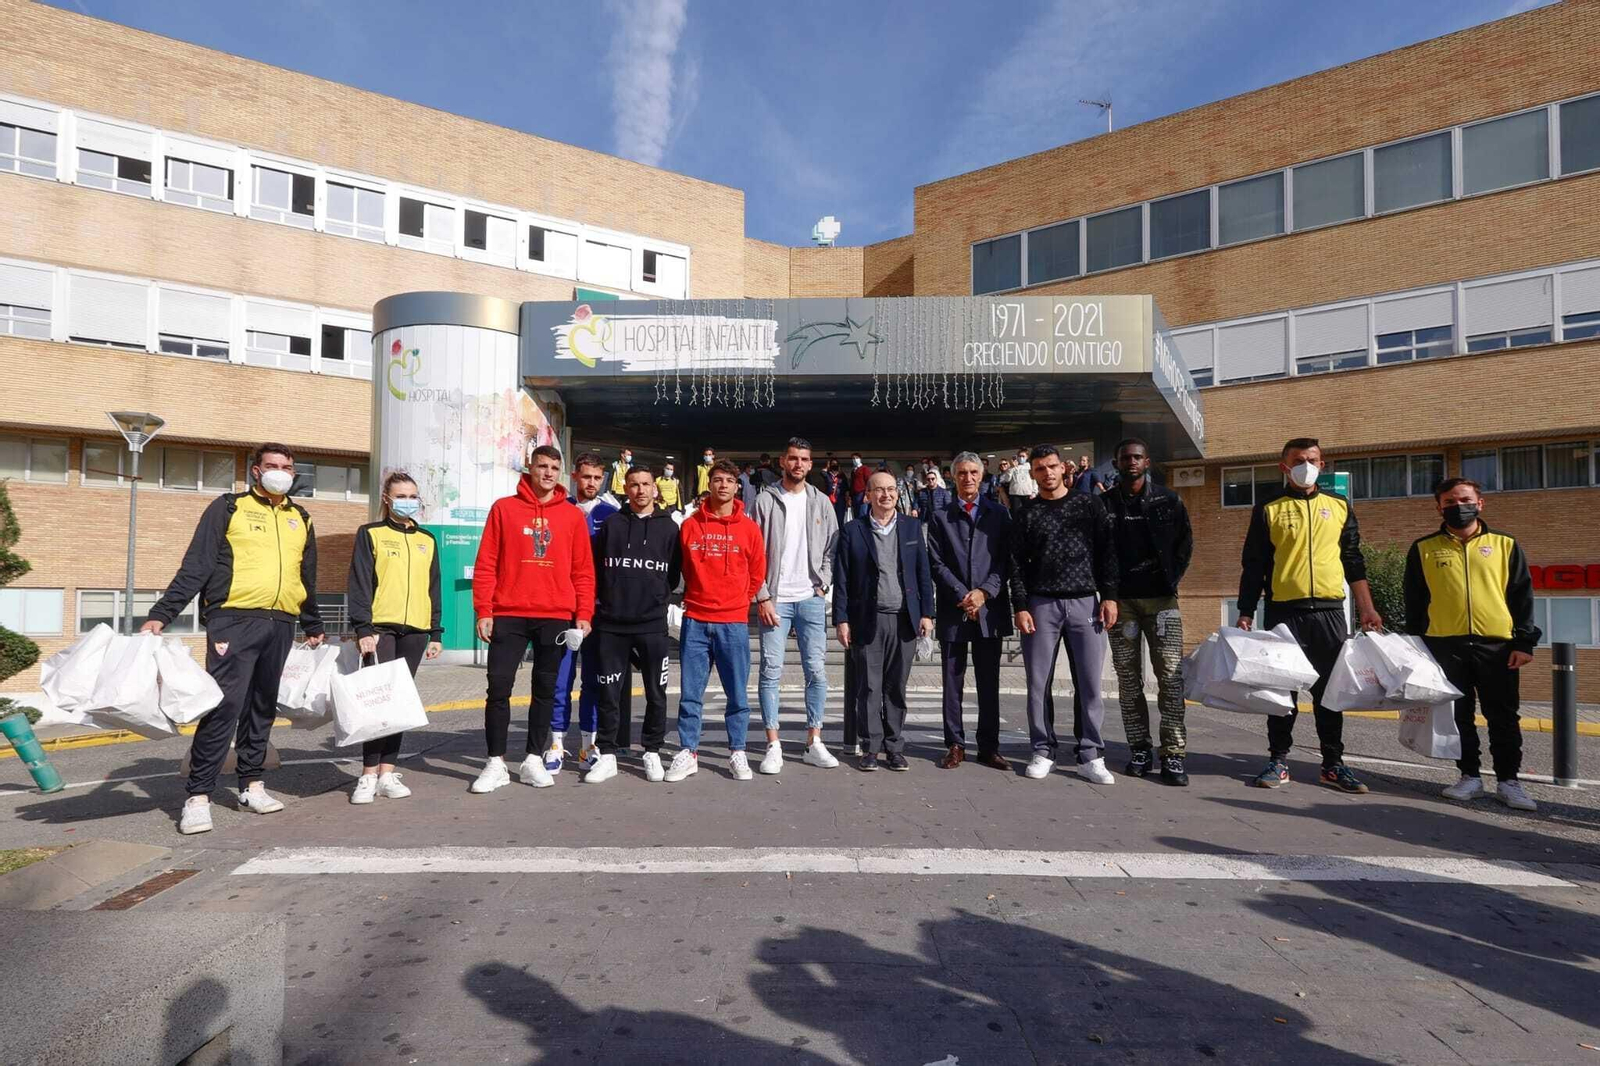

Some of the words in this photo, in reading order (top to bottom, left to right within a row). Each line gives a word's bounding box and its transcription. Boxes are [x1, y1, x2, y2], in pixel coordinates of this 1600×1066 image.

[992, 303, 1026, 338] 1971
[1053, 302, 1104, 337] 2021
[624, 324, 698, 352] HOSPITAL
[704, 324, 773, 351] INFANTIL
[963, 340, 1048, 367] CRECIENDO
[1054, 340, 1122, 366] CONTIGO
[408, 388, 453, 402] HOSPITAL
